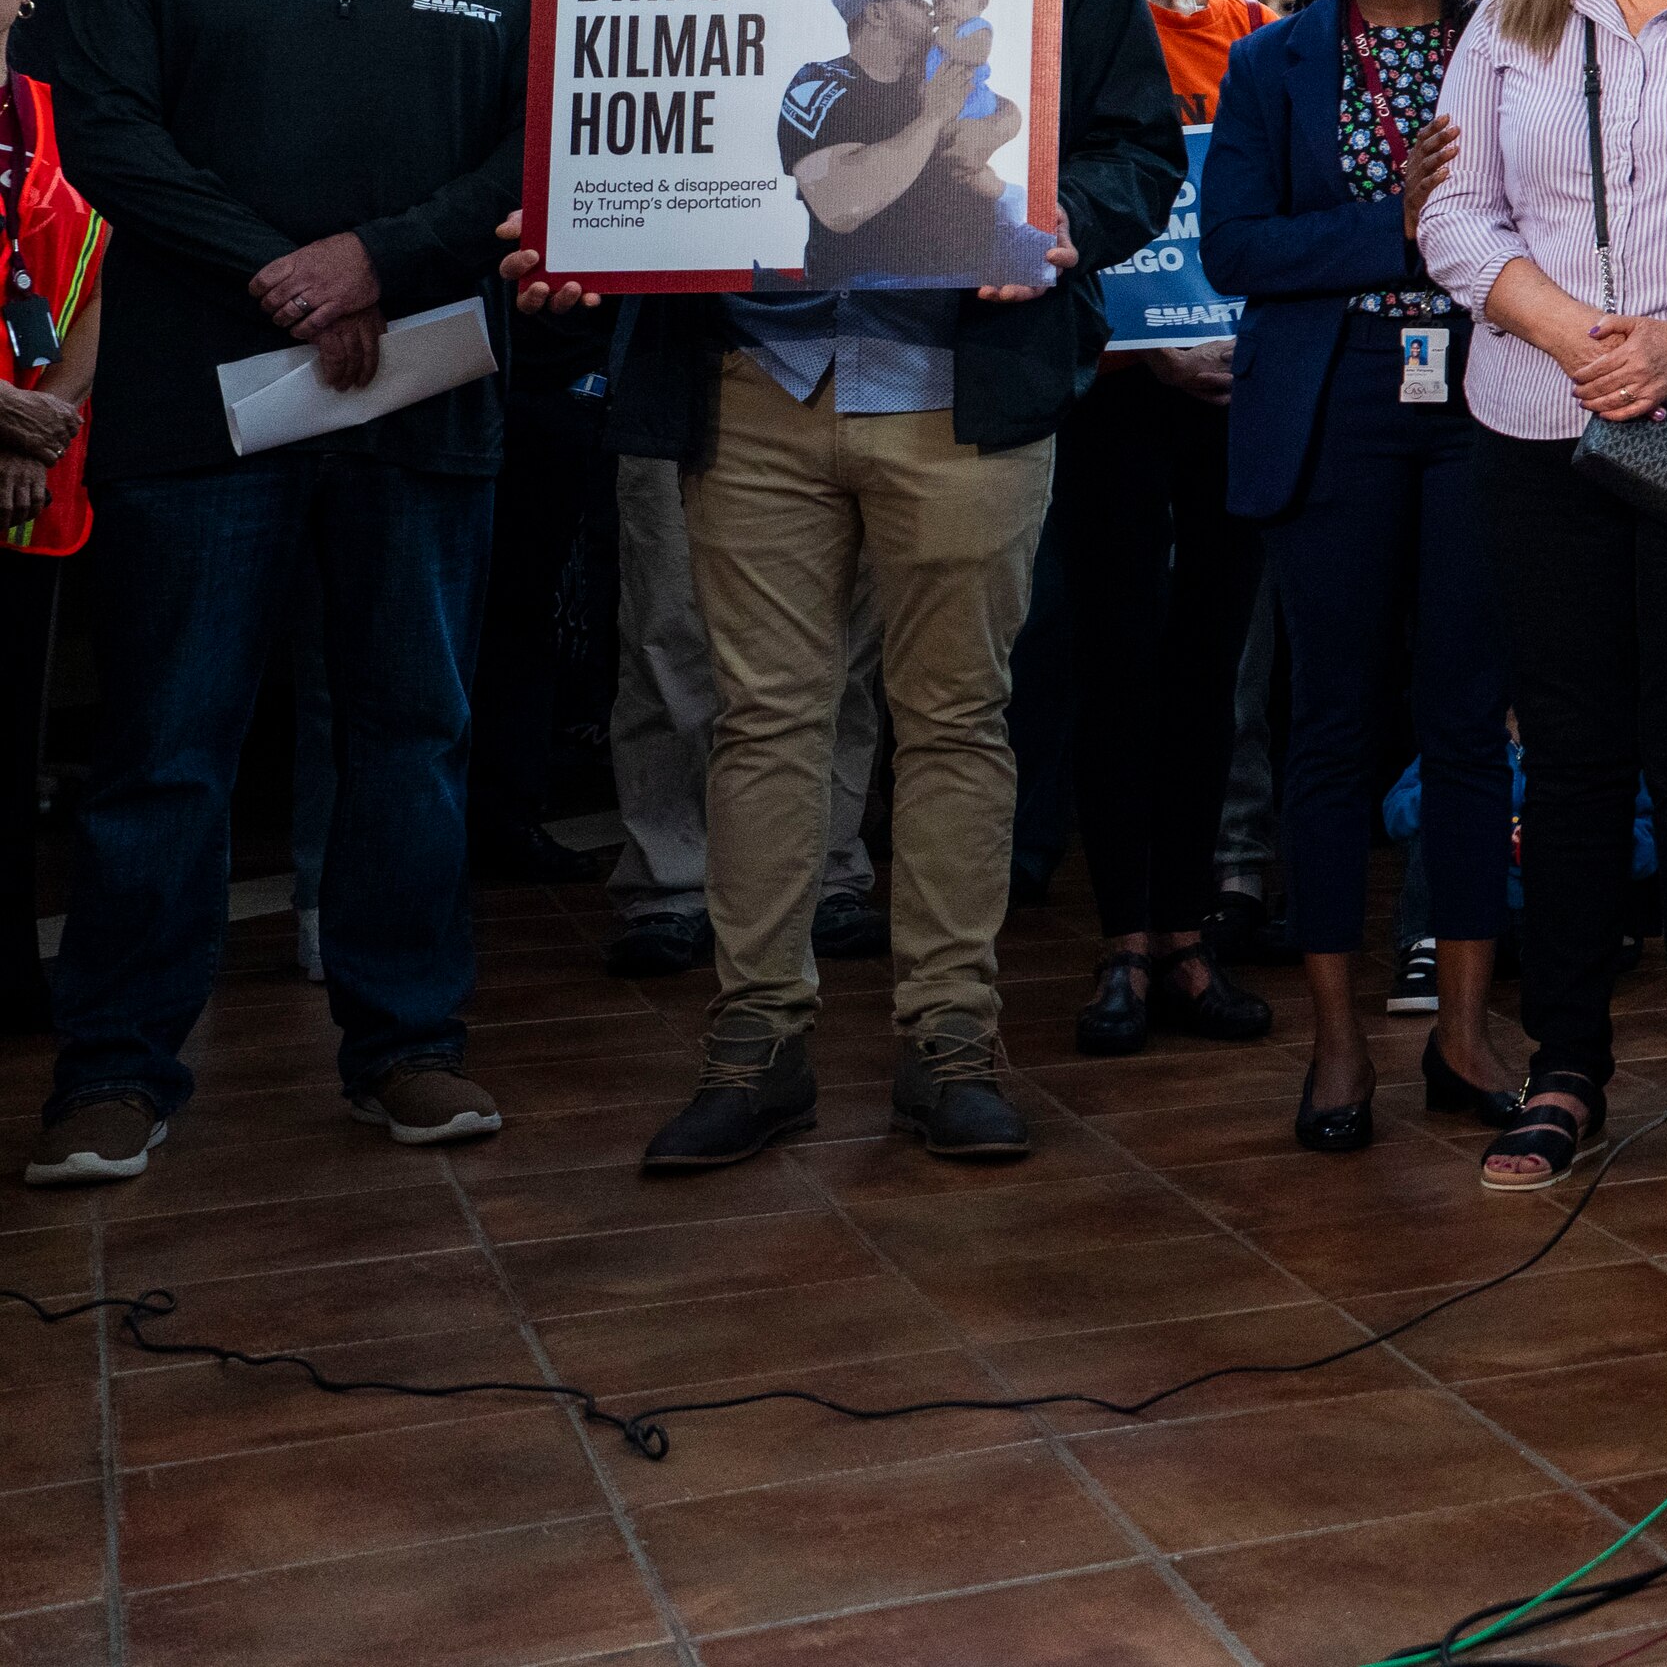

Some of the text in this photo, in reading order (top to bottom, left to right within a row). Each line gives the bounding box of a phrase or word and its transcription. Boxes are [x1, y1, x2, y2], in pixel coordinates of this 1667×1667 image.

[573, 13, 766, 79] KILMAR
[1355, 33, 1370, 57] CASA
[1374, 93, 1390, 118] CASA
[570, 90, 716, 156] HOME
[573, 177, 778, 197] Abducted & disappeared
[573, 195, 761, 215] by Trump's deportation
[572, 215, 645, 229] machine
